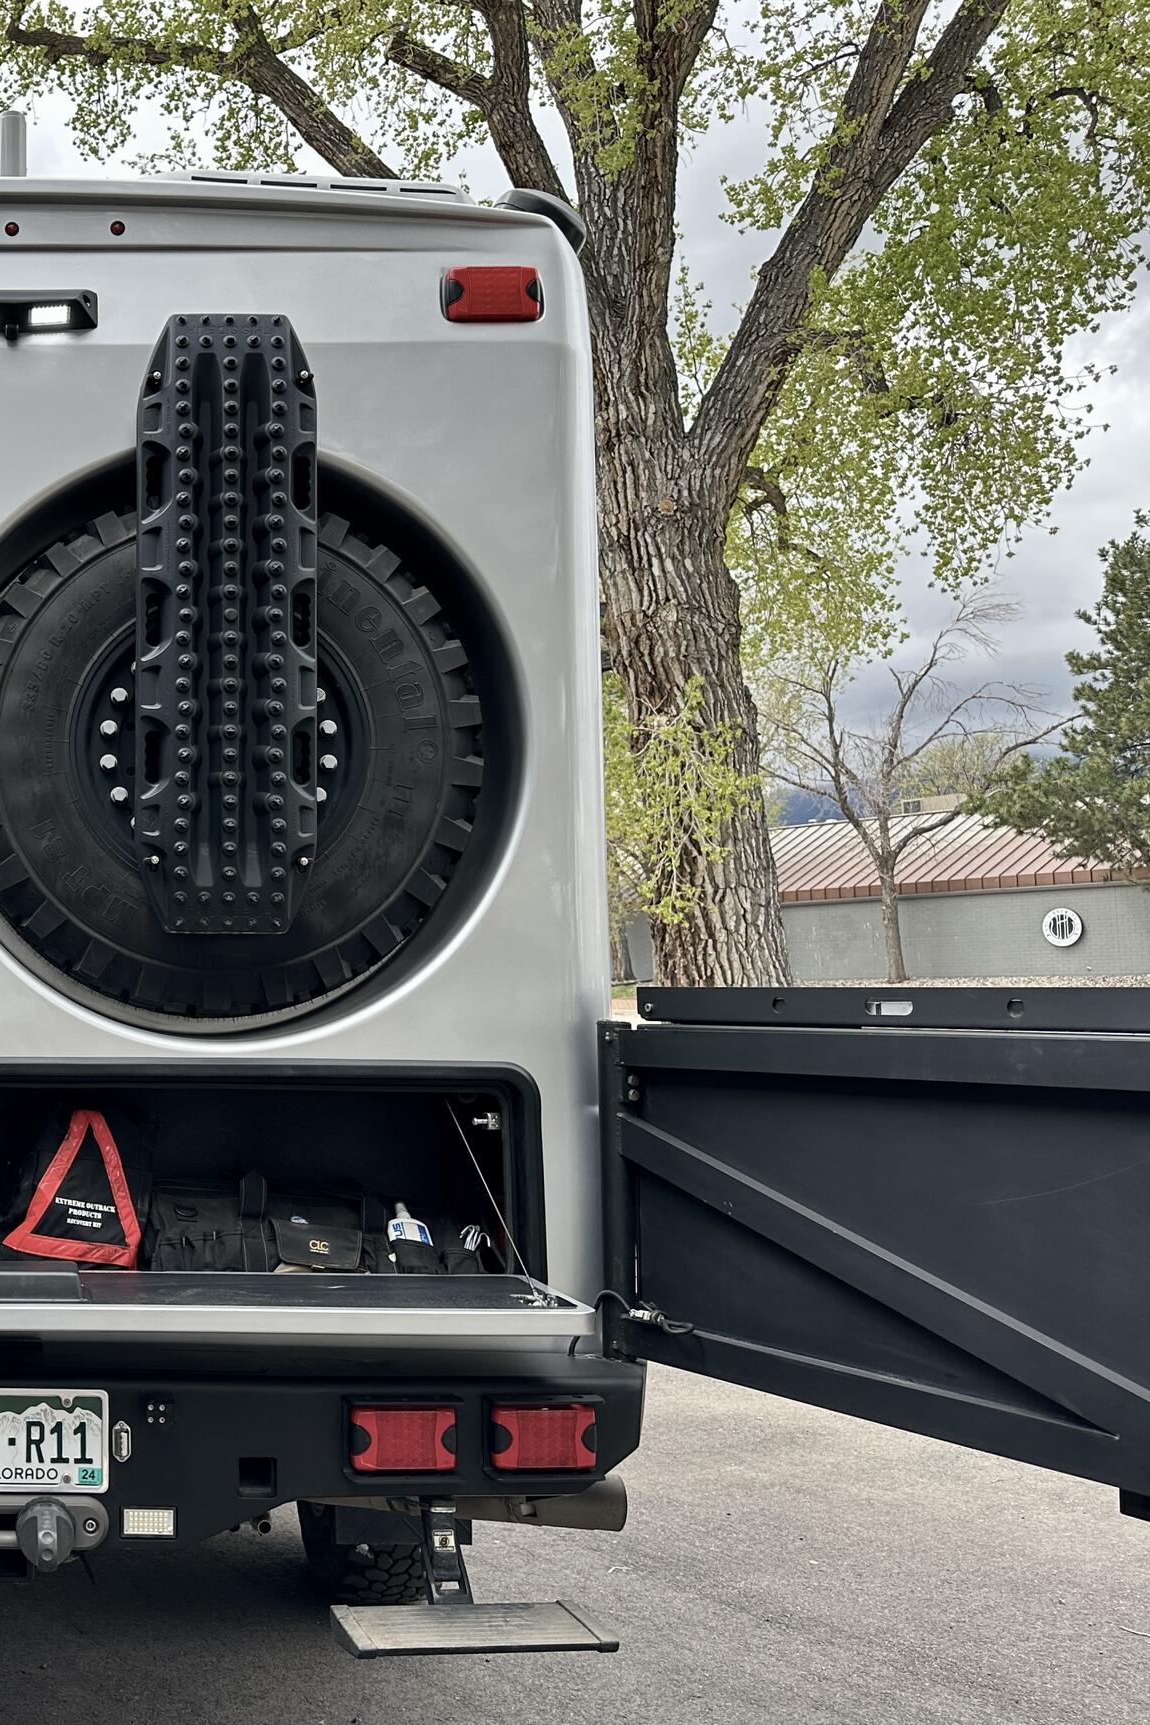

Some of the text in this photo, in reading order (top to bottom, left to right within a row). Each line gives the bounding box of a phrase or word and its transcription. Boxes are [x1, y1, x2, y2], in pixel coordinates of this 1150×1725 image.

[55, 1197, 85, 1208] EXTREME
[68, 1208, 102, 1219] PRODUCTS
[81, 1469, 96, 1480] 24
